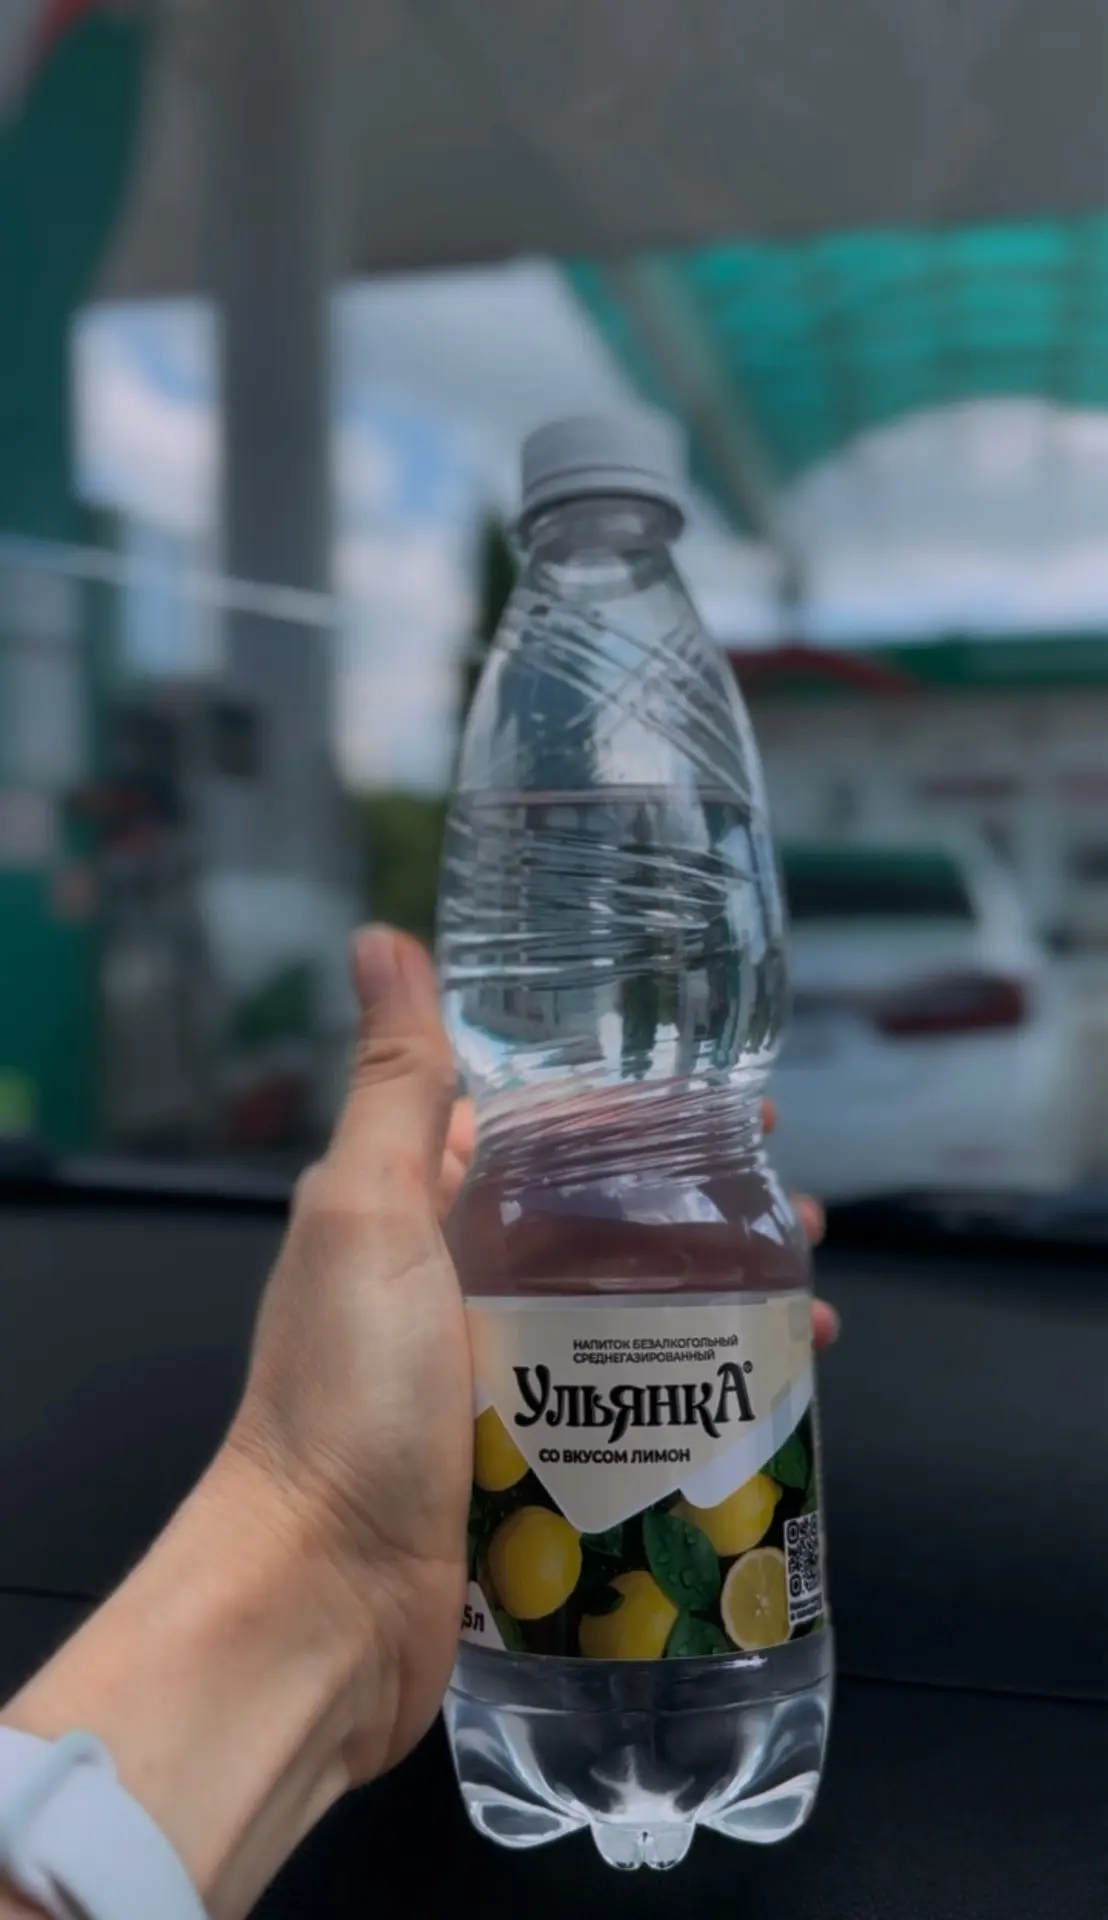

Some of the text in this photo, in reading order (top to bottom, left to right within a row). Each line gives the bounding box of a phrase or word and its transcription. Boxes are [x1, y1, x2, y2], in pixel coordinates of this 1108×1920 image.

[573, 1334, 739, 1350] НАПИТОК БЕЗАЛКОГОЛЬНЫЙ
[573, 1349, 716, 1364] СРЕДНЕГАЗИРОВАННЫЙ
[539, 1448, 691, 1464] СО ВКУСОМ ЛИМОН
